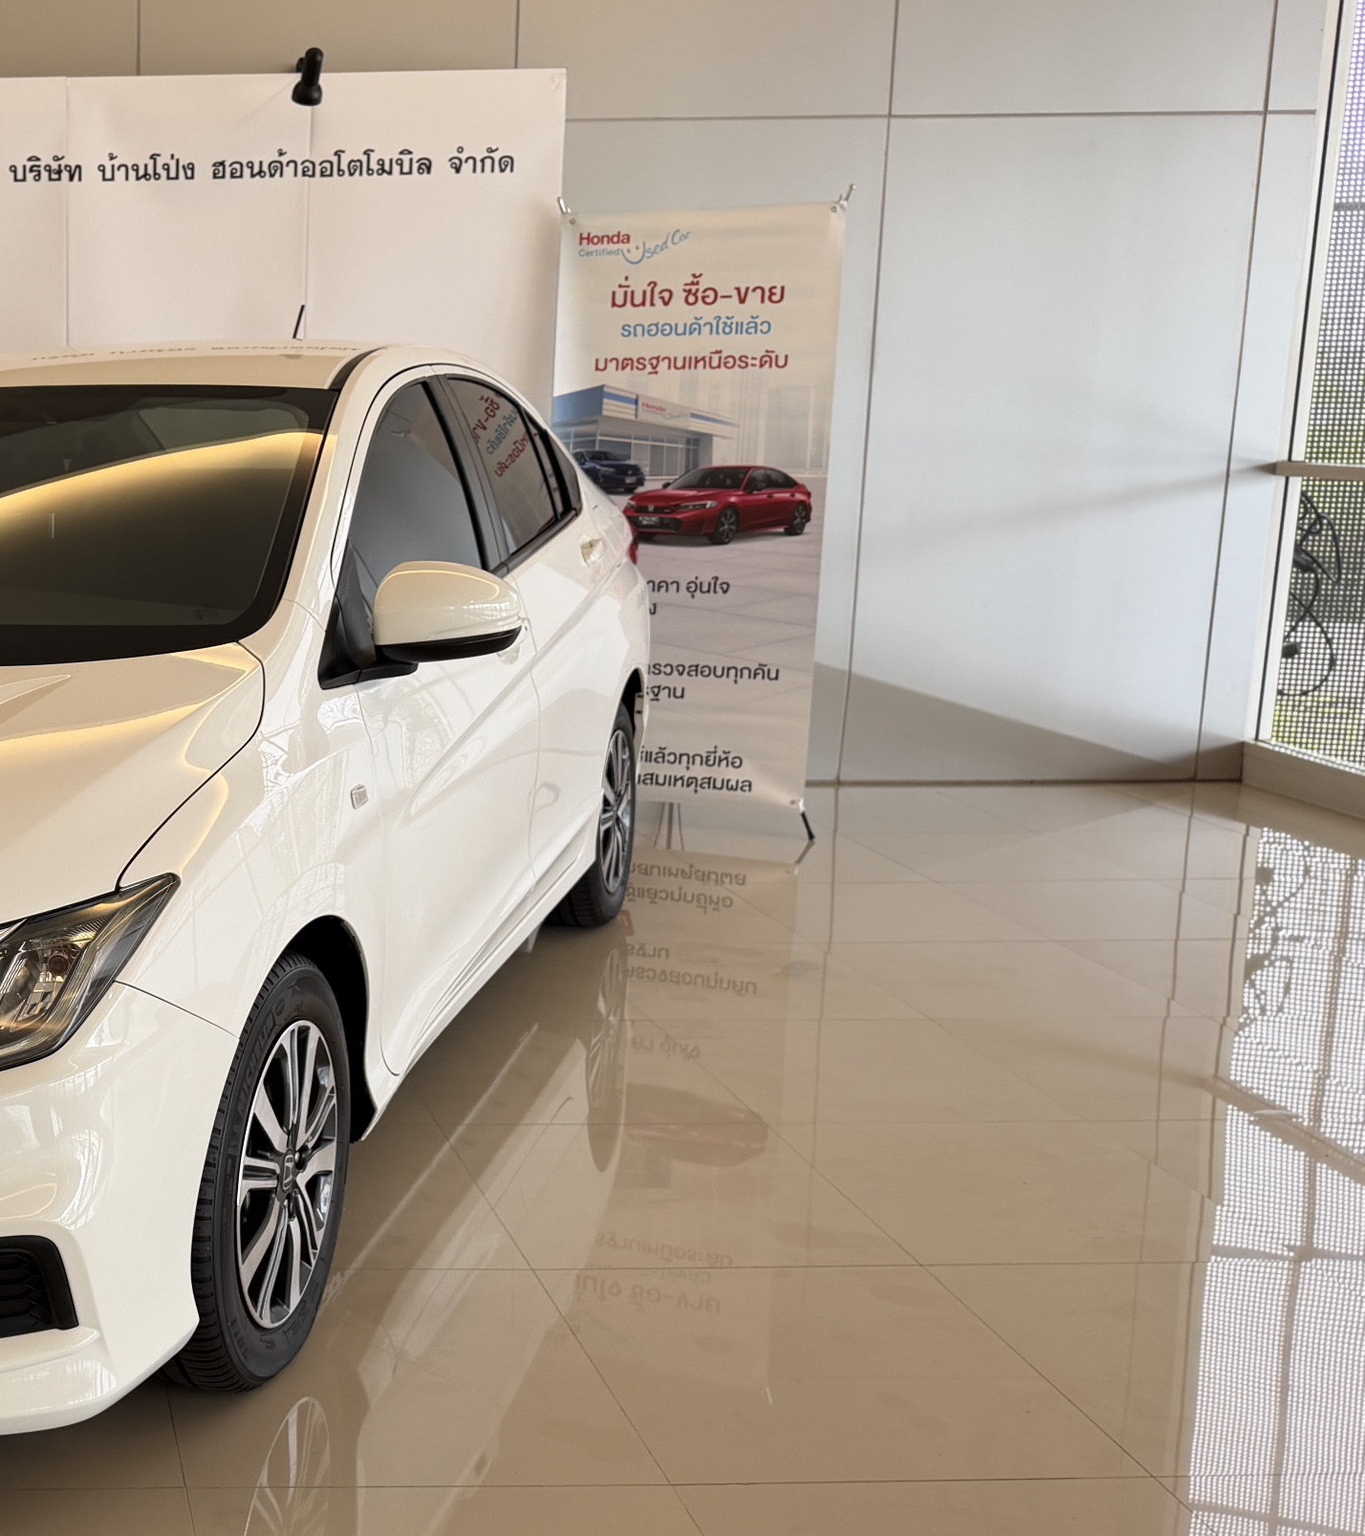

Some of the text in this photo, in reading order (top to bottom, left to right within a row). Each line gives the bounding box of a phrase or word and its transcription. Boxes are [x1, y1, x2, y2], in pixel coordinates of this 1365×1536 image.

[9, 146, 515, 182] บริษัท บ้านโป่ง ฮอนด้าออโตโมบิล จำกัด
[578, 230, 631, 247] Honda
[578, 228, 691, 265] Certified Used Car
[611, 272, 786, 309] มั่นใจ ซื้อ-ขาย
[620, 315, 773, 338] รถฮอนด้าใช้แล้ว
[594, 349, 789, 376] มาตรฐานเหนือระดับ
[647, 576, 731, 599] าคา อุ่นใจ
[640, 745, 744, 771] แล้วทุกยี่ห้อ
